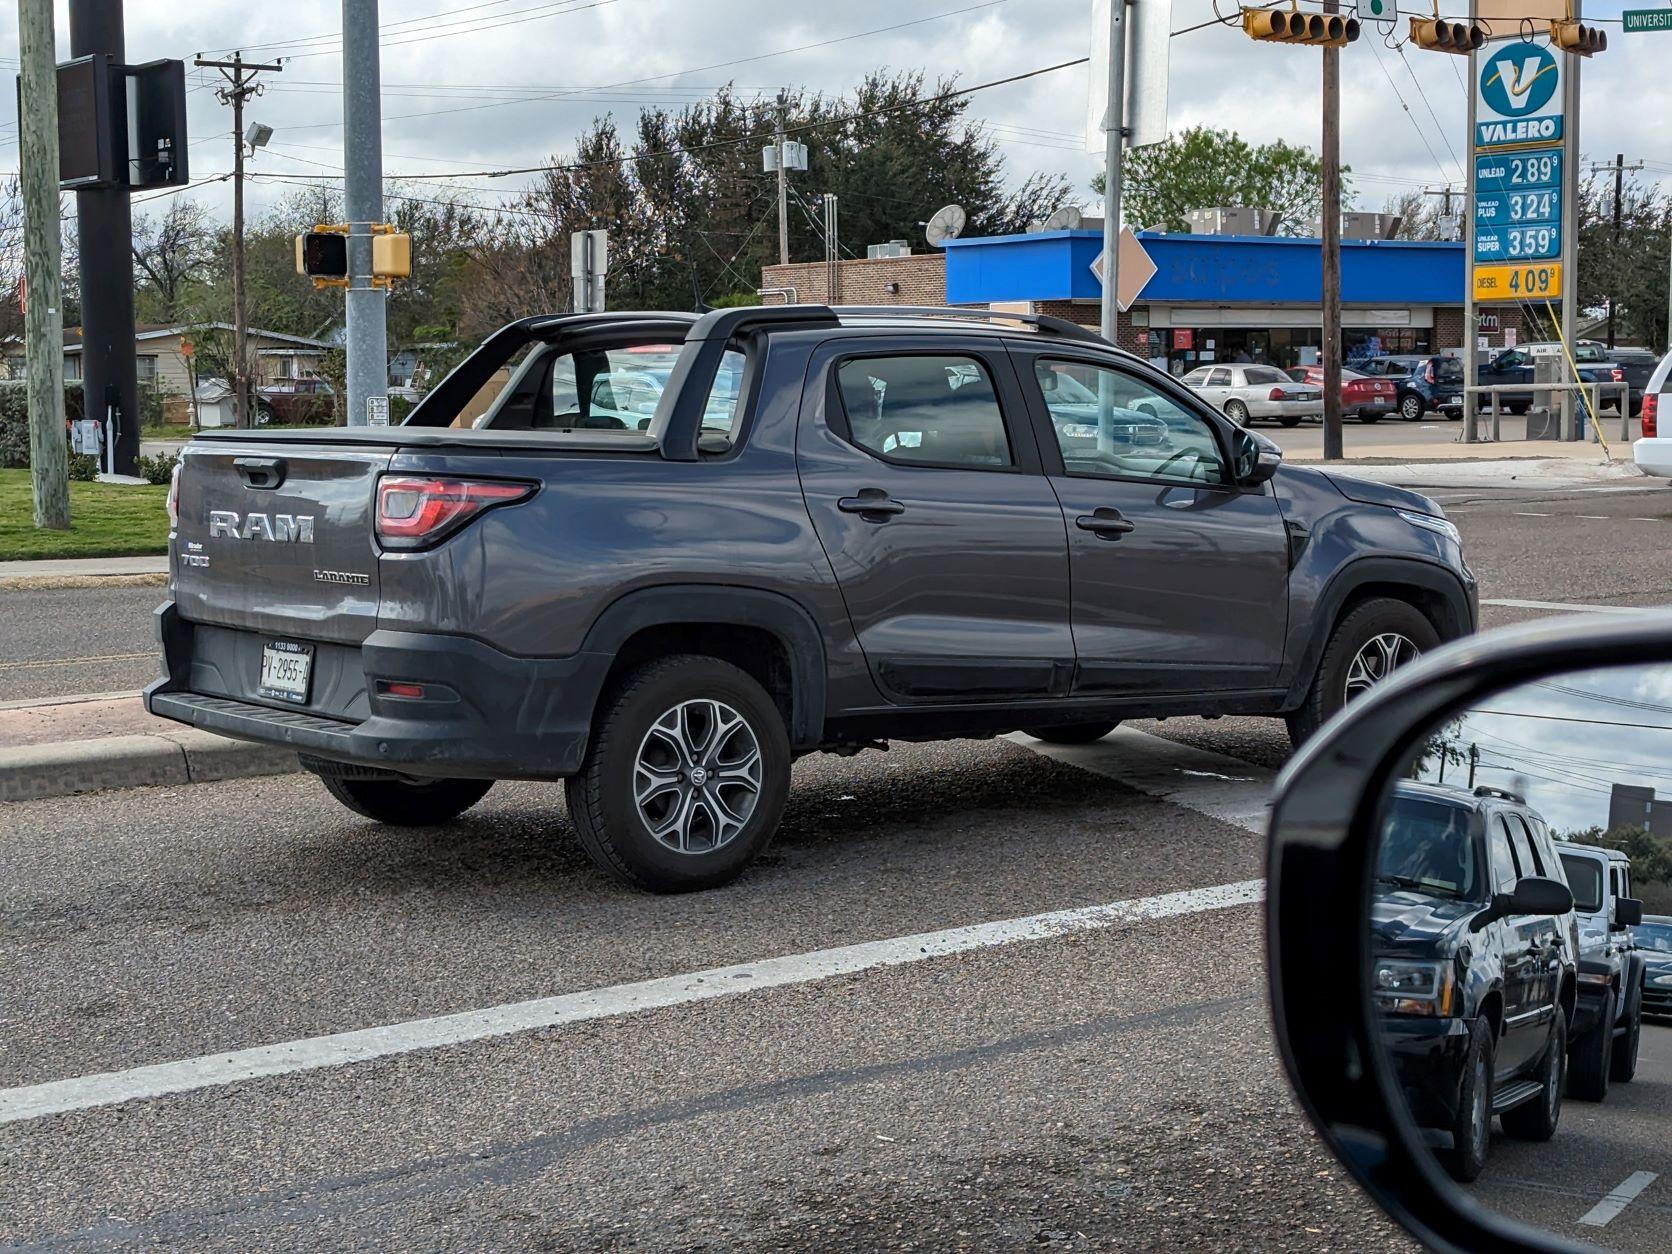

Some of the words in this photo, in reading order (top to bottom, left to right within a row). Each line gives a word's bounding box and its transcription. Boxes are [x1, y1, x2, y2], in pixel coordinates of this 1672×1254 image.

[1480, 119, 1556, 144] VALERO
[1478, 165, 1505, 179] UNLEAD
[1477, 200, 1499, 208] UNLEAD
[1477, 206, 1496, 218] PLUS
[1476, 240, 1500, 253] SUPER
[1476, 276, 1498, 289] DIESEL
[209, 510, 315, 544] RAM
[313, 569, 371, 586] LARAMIE
